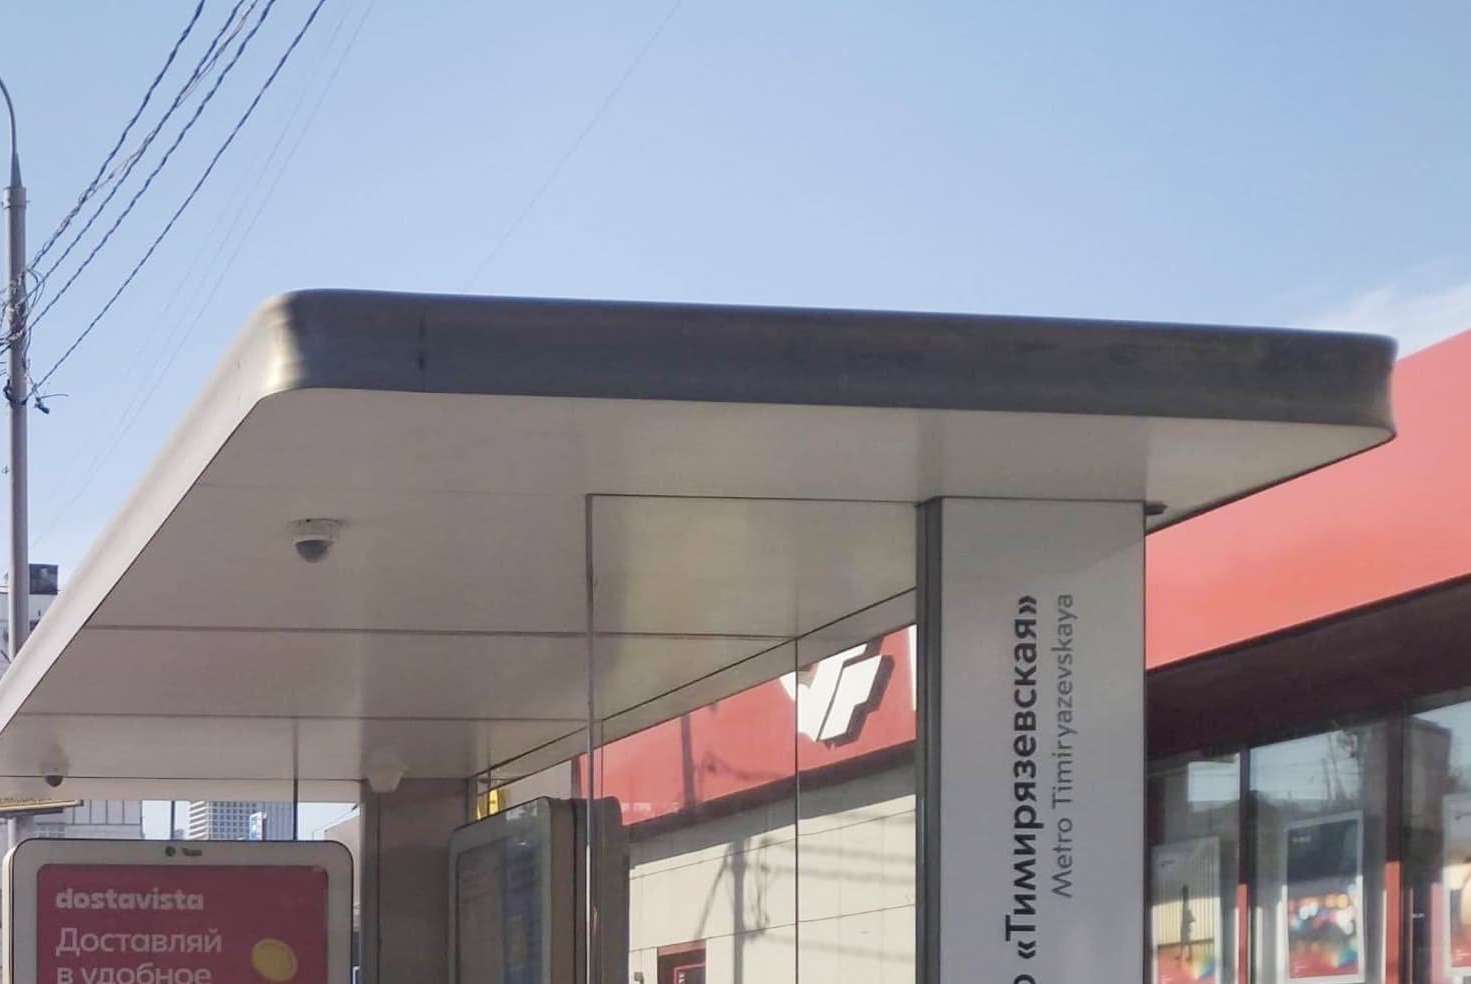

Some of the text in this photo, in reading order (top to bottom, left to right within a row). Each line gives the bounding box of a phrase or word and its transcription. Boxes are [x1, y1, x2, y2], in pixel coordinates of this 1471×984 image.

[1005, 594, 1044, 960] «Тимирязевская»
[1050, 593, 1078, 898] Metro Timiryazevskaya
[55, 887, 205, 911] dostavista
[55, 927, 223, 957] Доставляй
